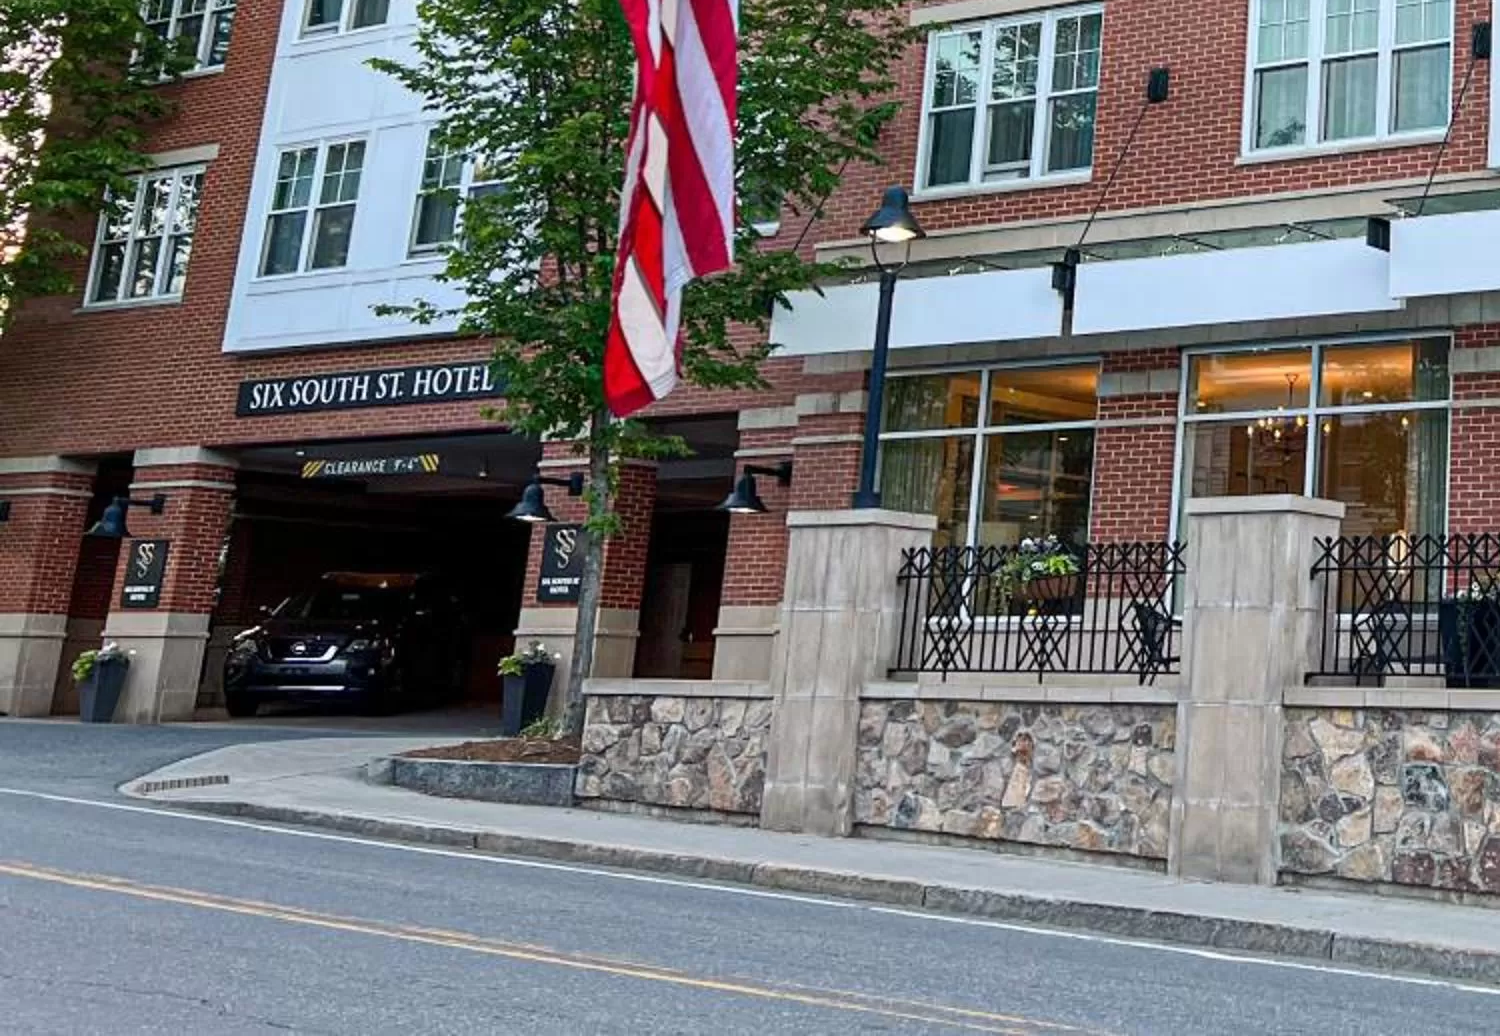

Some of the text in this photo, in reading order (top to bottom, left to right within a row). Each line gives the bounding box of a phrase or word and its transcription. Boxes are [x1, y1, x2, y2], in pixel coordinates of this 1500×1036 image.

[250, 365, 494, 409] SIX SOUTH ST. HOTEL
[324, 460, 386, 475] CLEARANCE
